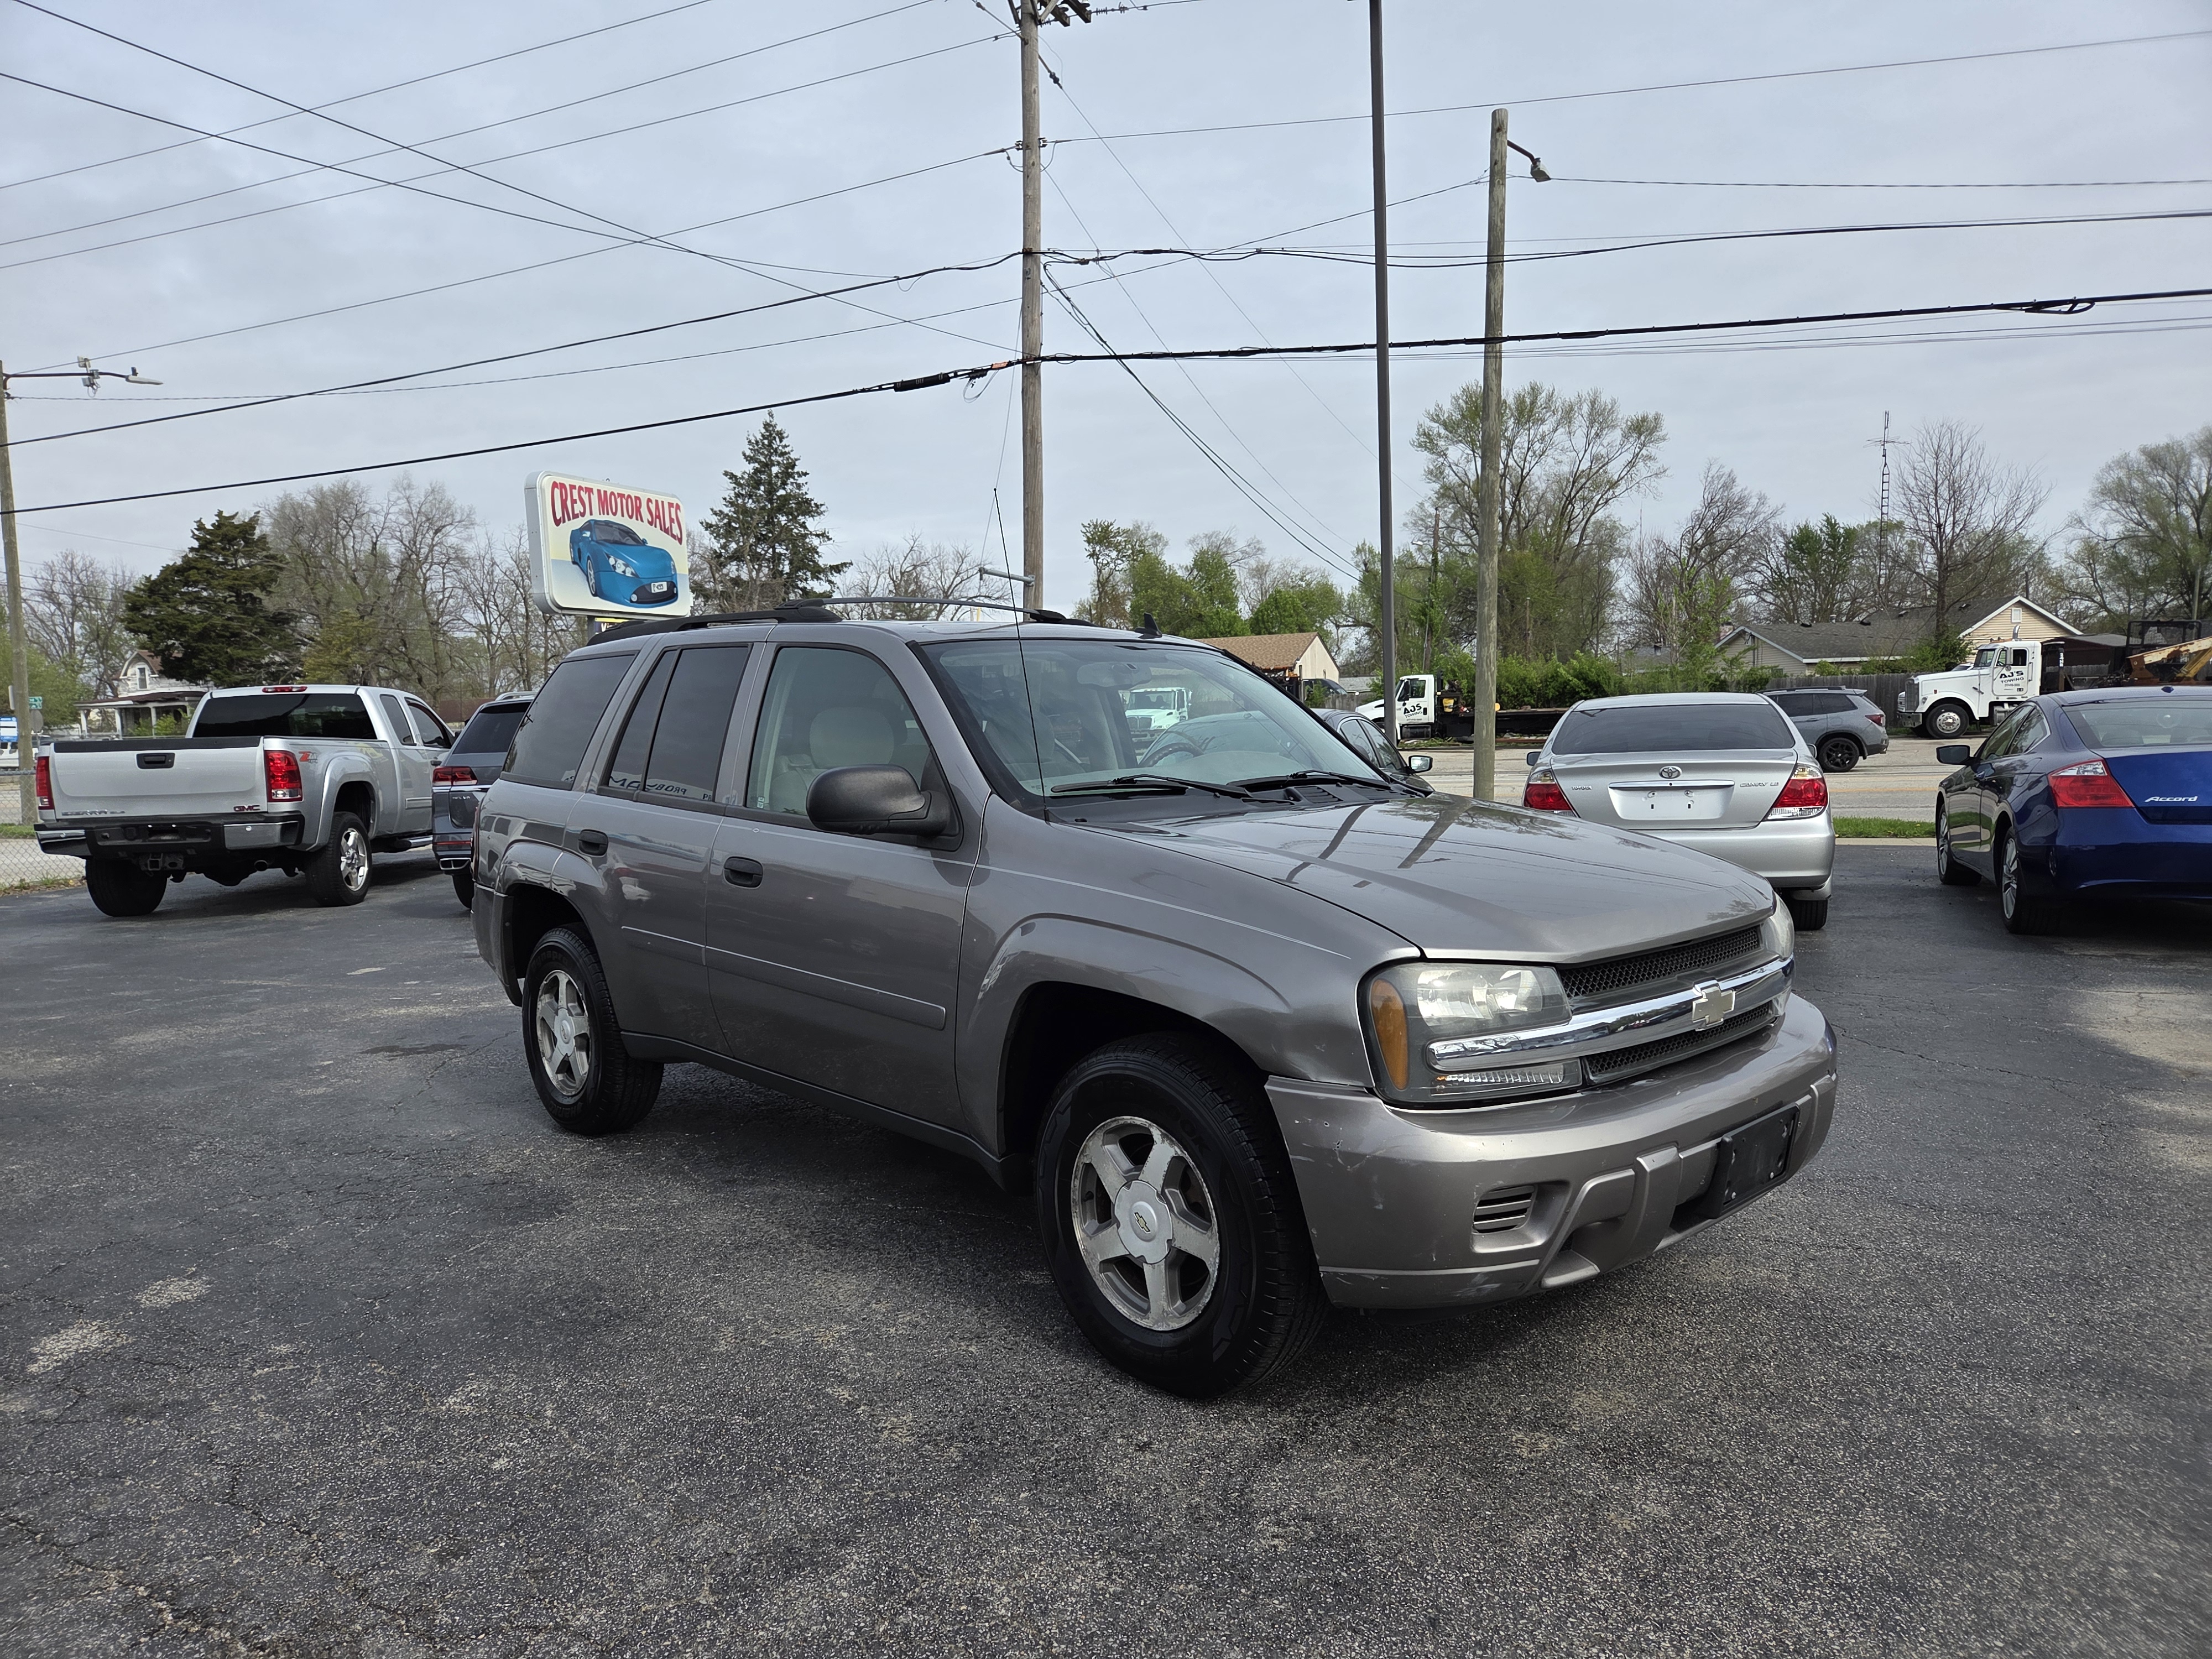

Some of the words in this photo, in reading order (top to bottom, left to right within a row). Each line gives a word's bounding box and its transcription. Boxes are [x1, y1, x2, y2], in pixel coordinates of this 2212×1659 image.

[551, 481, 594, 527] CREST
[597, 489, 644, 523] MOTOR
[646, 498, 683, 545] SALES
[1999, 670, 2024, 679] AJ'S
[1405, 710, 1423, 718] TOWING
